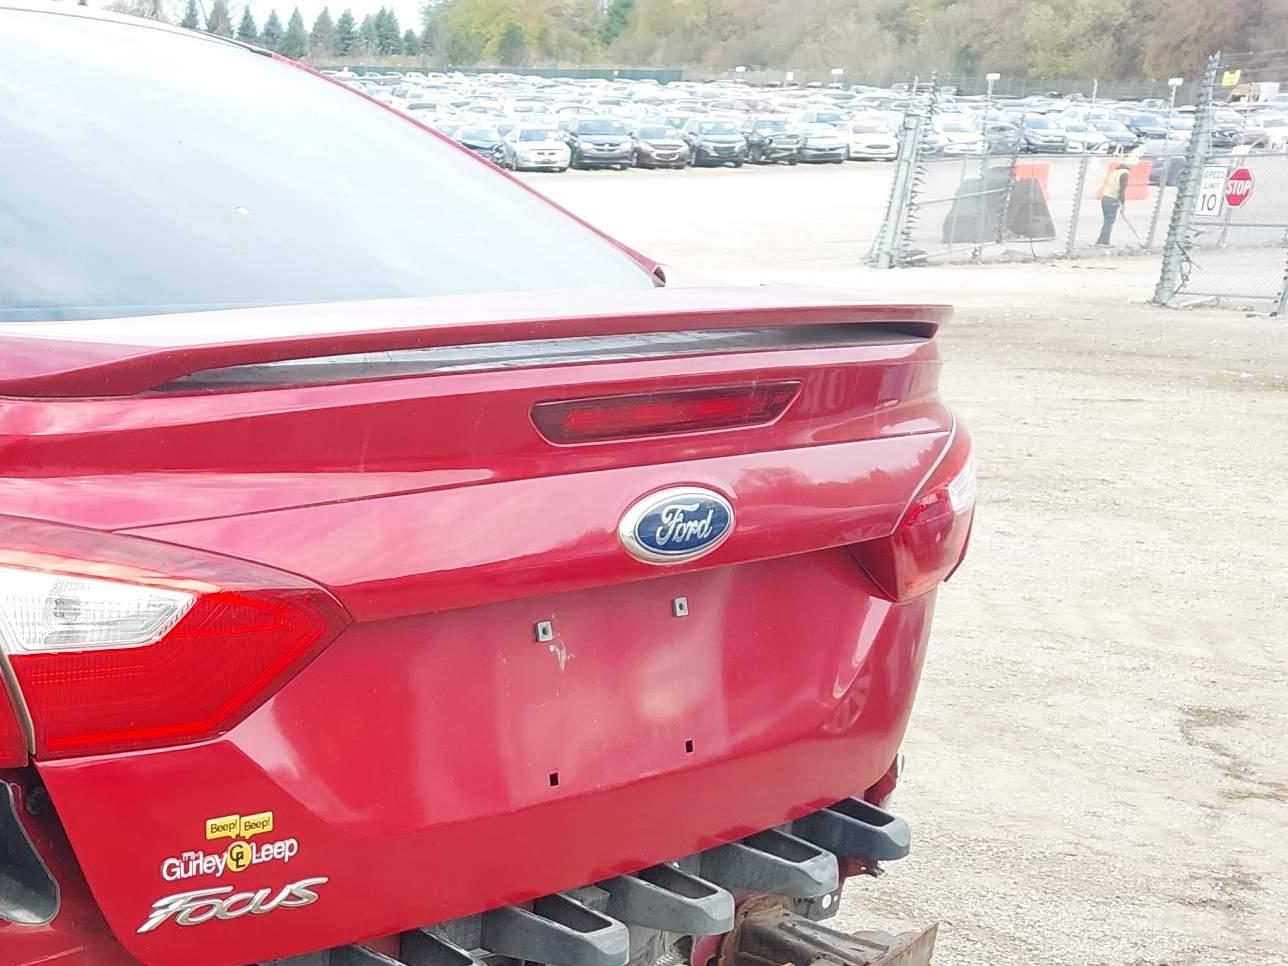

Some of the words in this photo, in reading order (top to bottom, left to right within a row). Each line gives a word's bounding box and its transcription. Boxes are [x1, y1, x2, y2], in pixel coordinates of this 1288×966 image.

[1225, 180, 1251, 195] STOP
[1200, 194, 1217, 211] 10
[655, 502, 714, 546] Ford
[210, 819, 238, 834] Beep!
[243, 817, 271, 832] Beep!
[162, 850, 227, 881] Gurley
[251, 838, 298, 864] Leep
